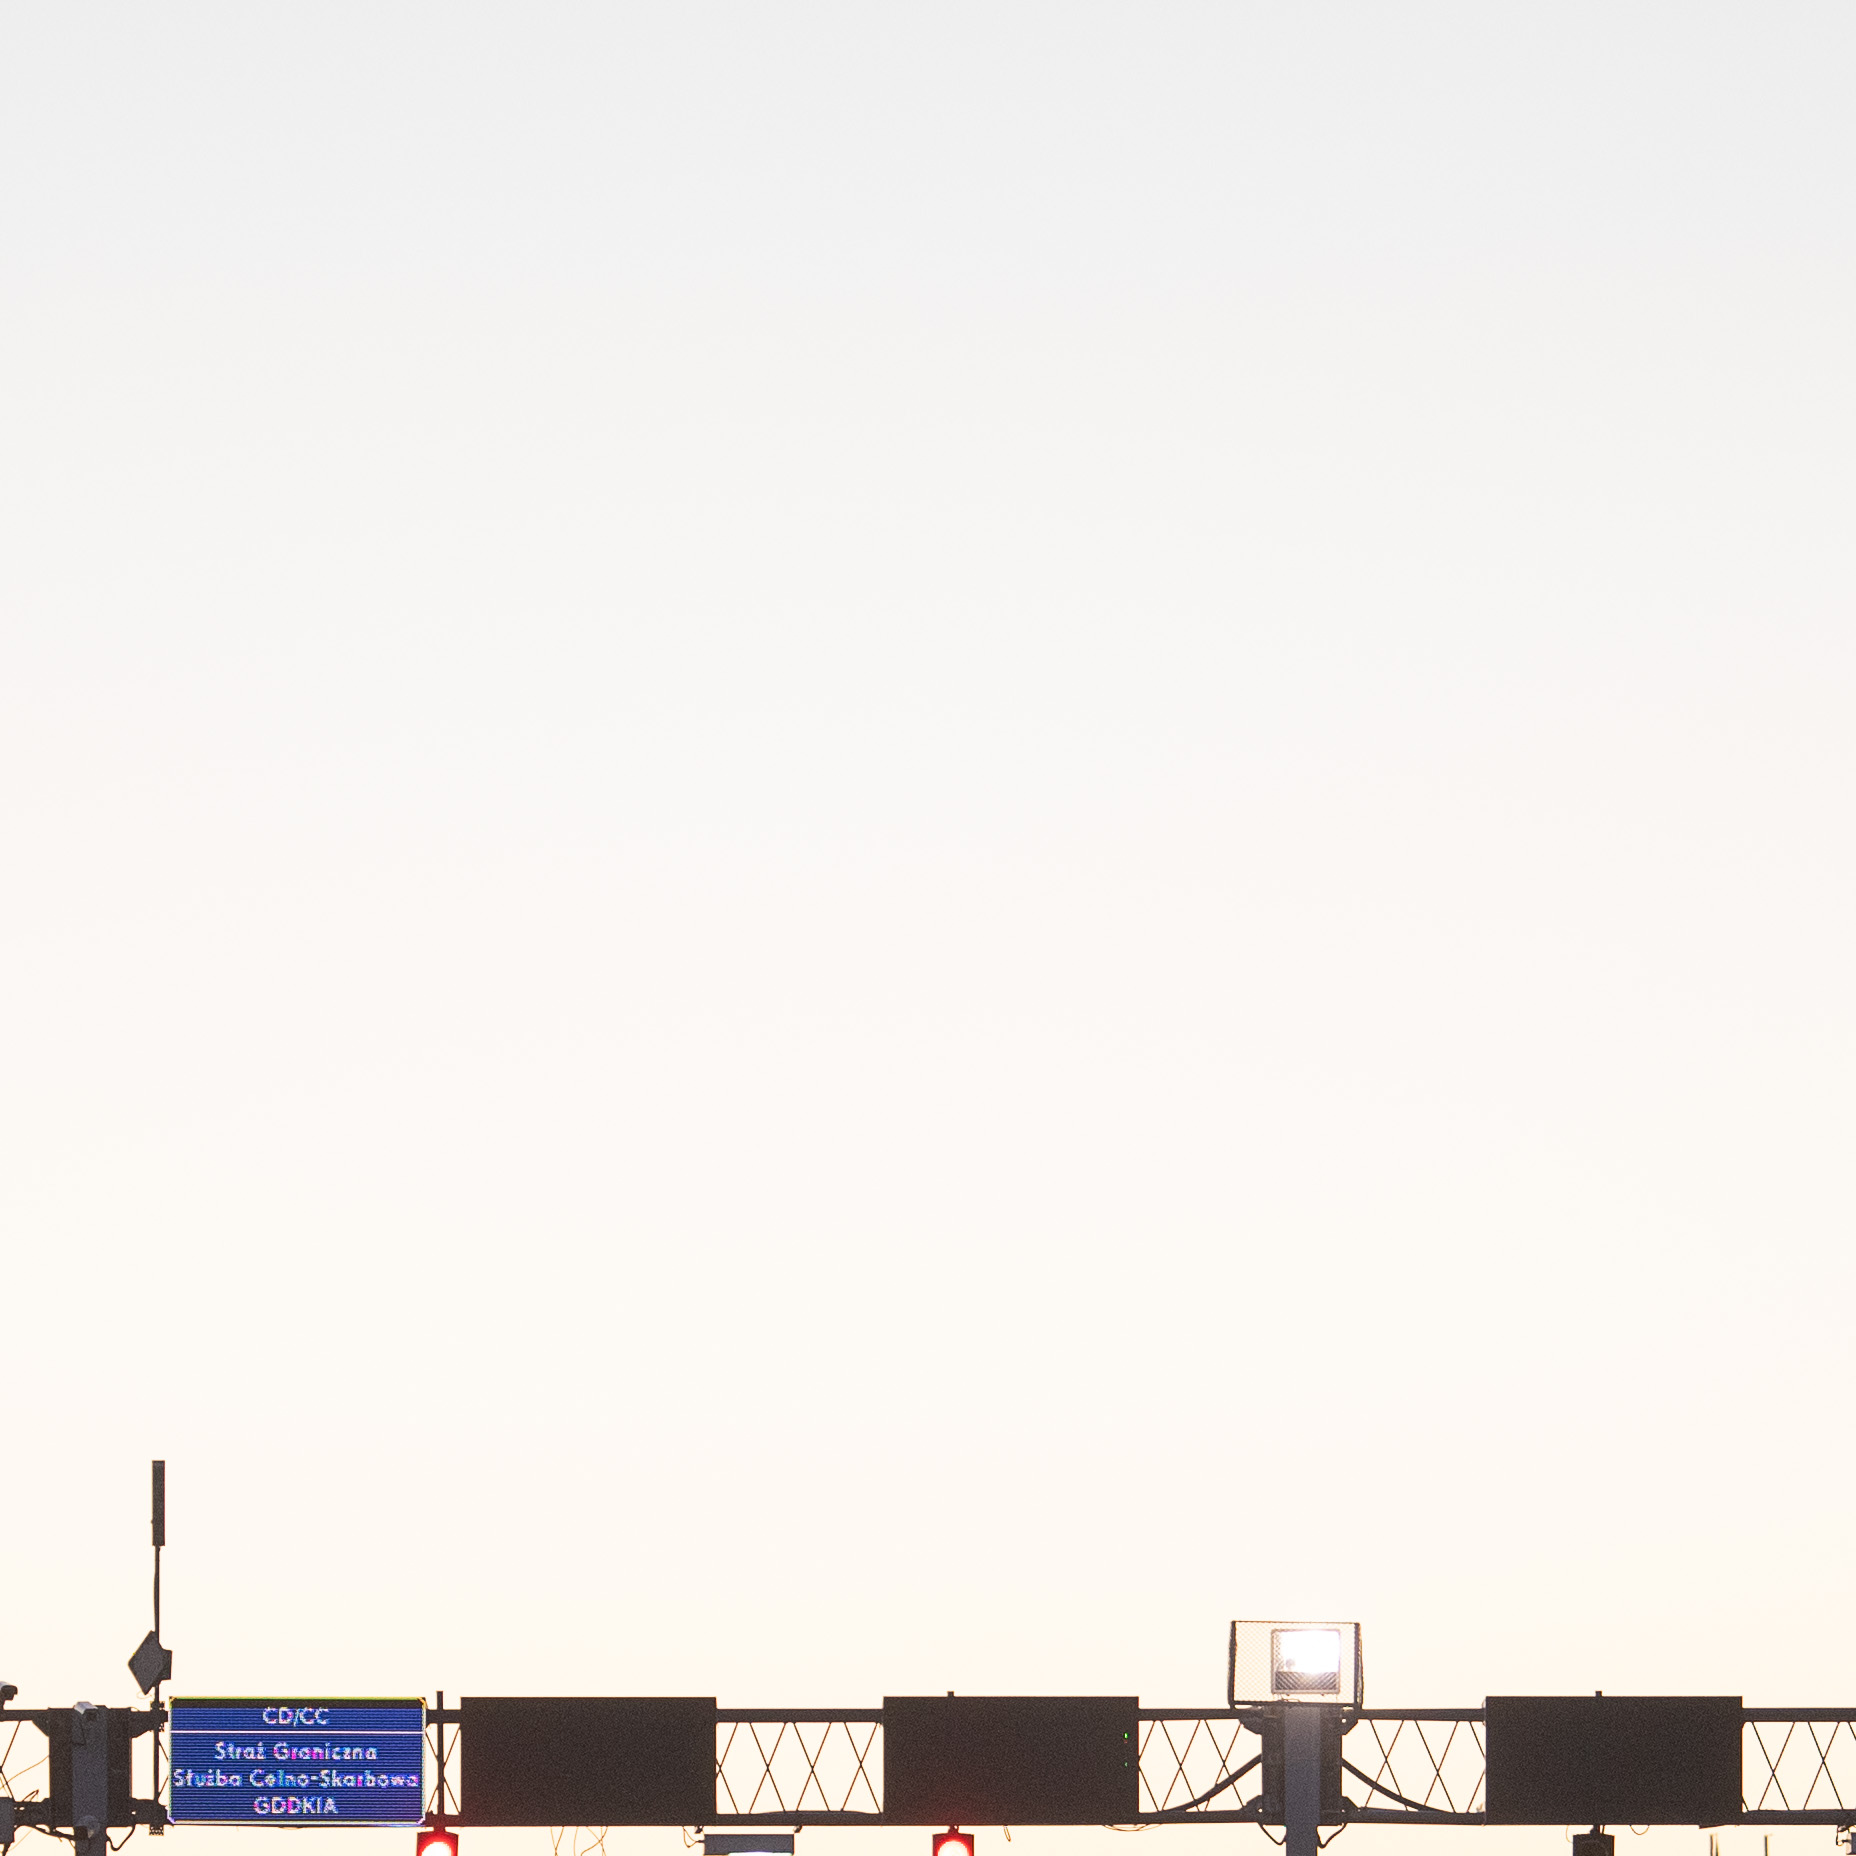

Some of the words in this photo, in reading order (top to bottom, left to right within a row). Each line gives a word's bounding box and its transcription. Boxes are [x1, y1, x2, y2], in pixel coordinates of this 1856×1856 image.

[214, 1741, 267, 1761] Straż
[273, 1741, 378, 1761] Graniczna
[249, 1768, 419, 1788] Celno-Skarbowa
